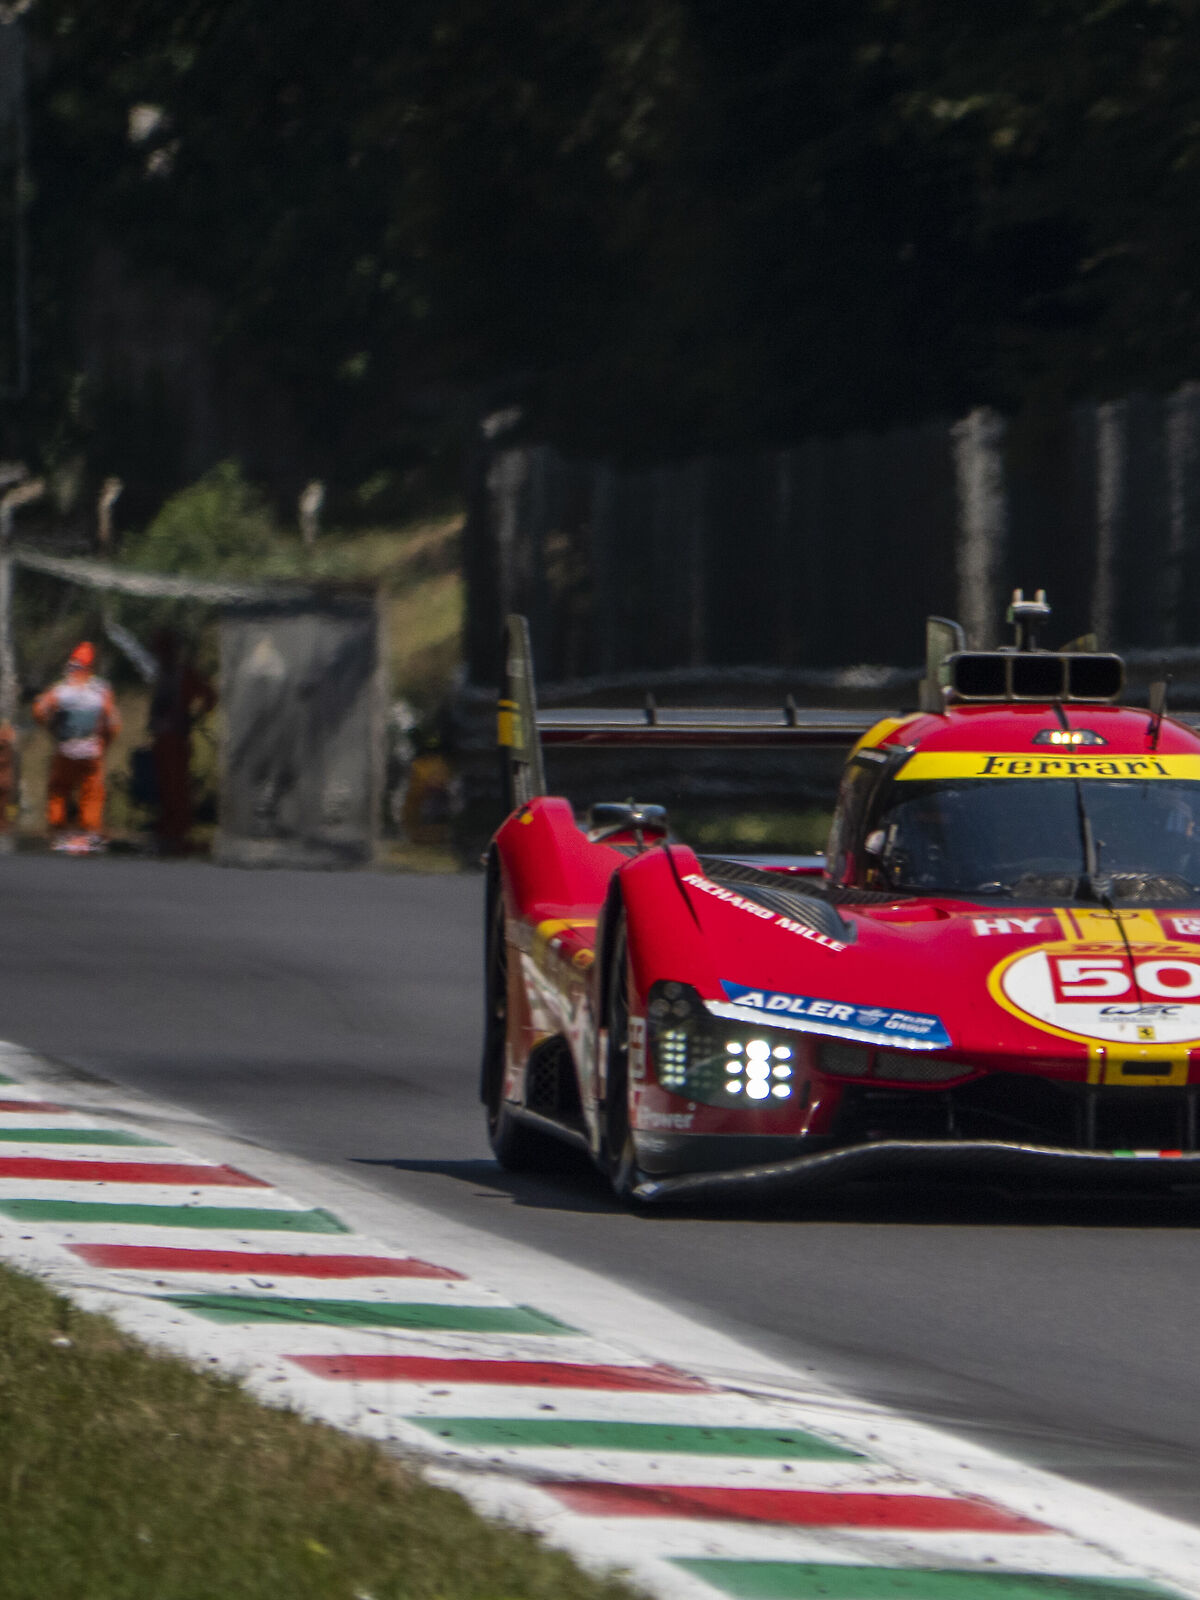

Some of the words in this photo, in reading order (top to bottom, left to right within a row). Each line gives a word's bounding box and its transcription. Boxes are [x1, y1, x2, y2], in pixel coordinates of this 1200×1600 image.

[976, 756, 1171, 776] Ferrari
[681, 873, 776, 920] RICHARD
[774, 917, 848, 952] MILLE
[973, 917, 1043, 937] HY
[731, 992, 856, 1021] ADLER
